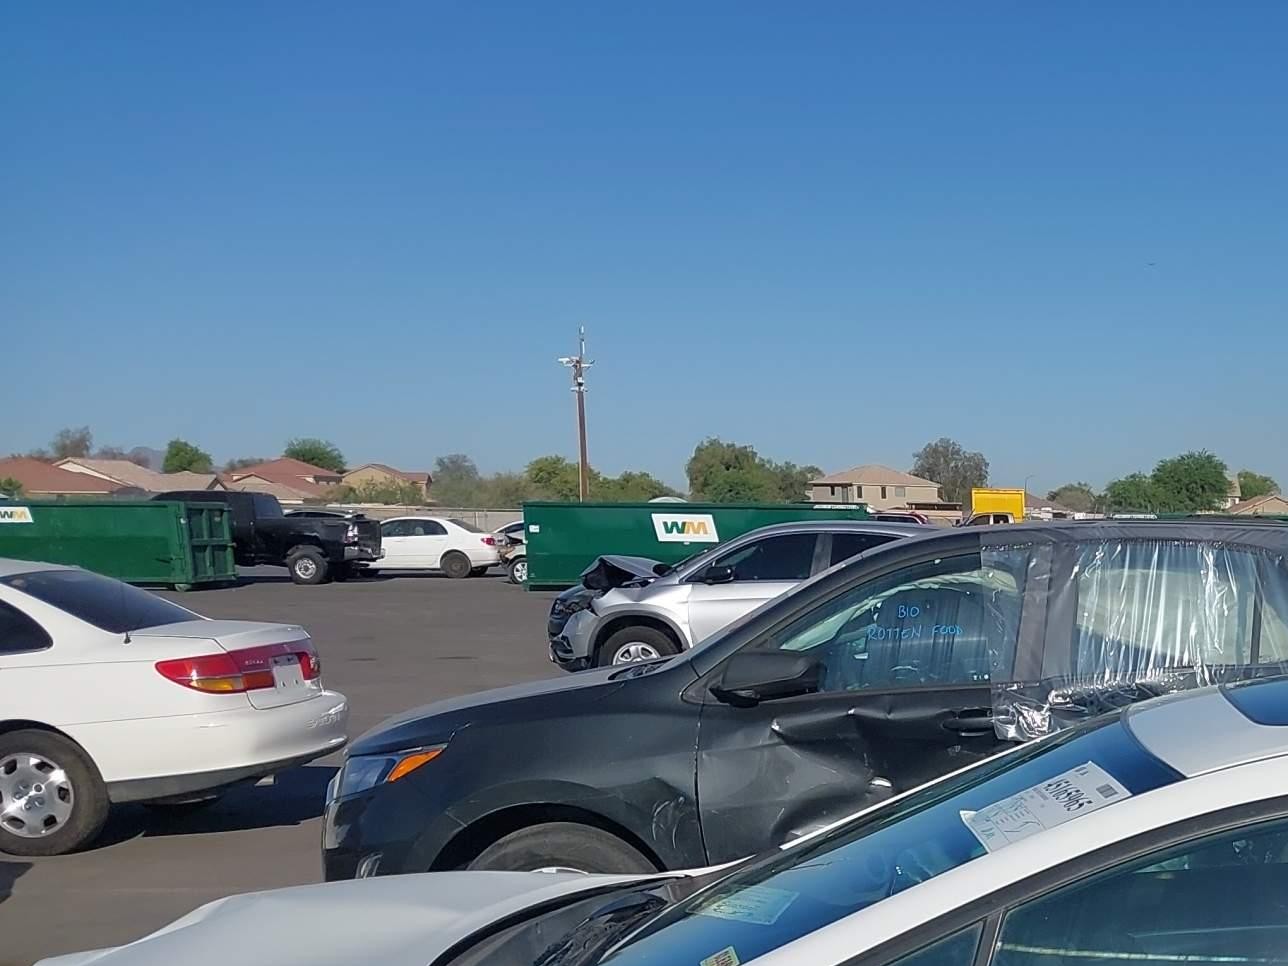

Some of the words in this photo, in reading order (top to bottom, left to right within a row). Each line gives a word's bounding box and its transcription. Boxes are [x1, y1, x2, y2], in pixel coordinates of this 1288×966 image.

[662, 521, 708, 535] WM
[898, 605, 920, 618] BIO
[867, 624, 922, 640] ROTTEN
[931, 624, 963, 637] FOOD
[1043, 778, 1094, 812] 45165965
